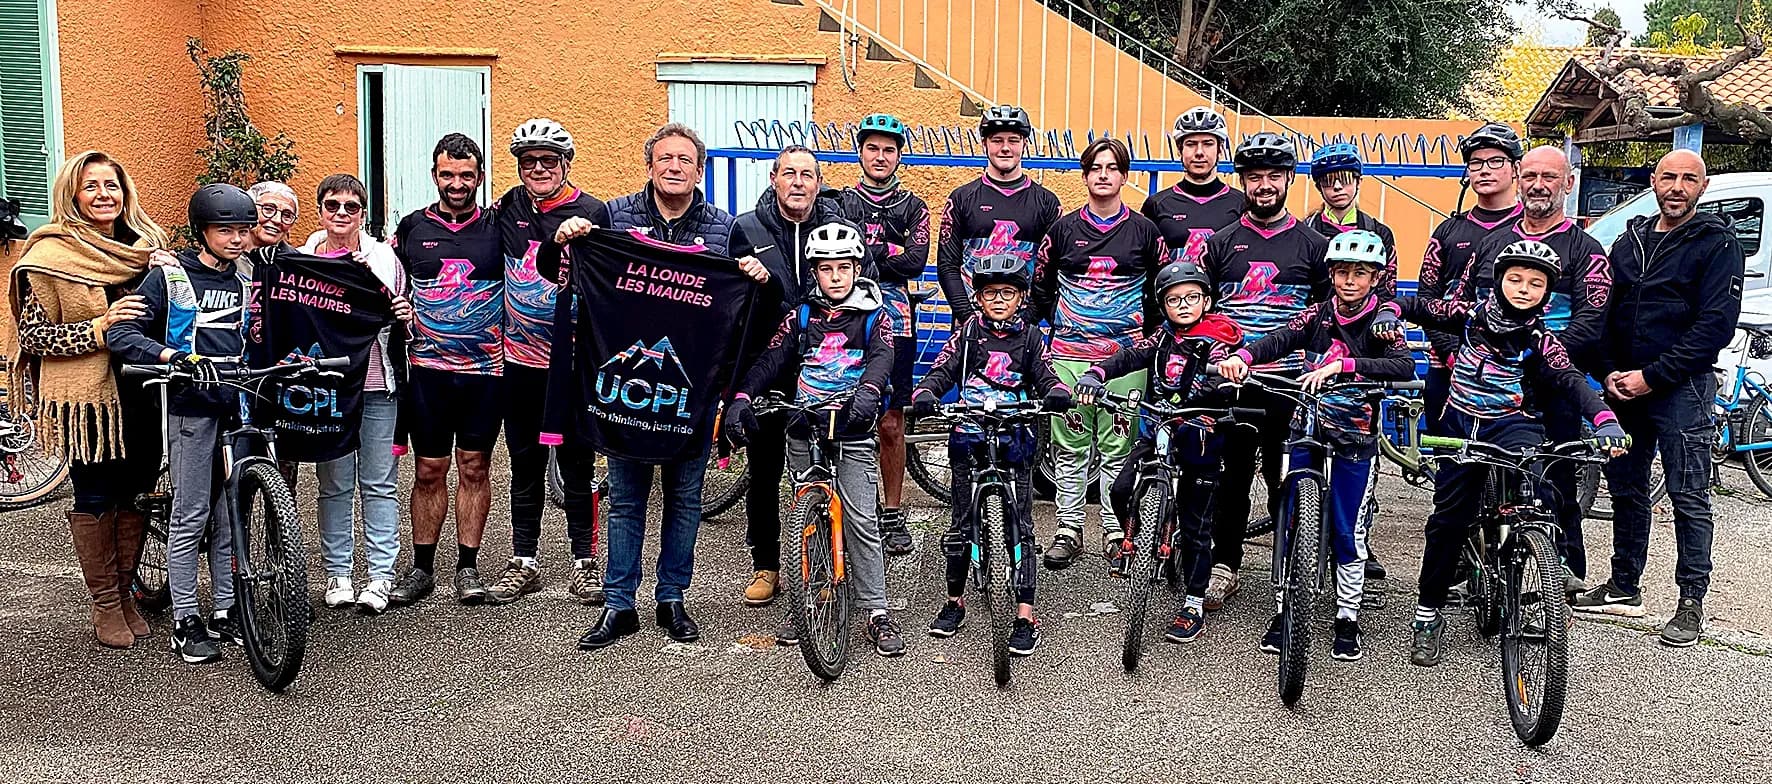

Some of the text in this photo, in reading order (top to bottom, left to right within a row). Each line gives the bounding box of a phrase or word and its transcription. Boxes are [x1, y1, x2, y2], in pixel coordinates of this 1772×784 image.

[279, 271, 348, 298] LA LONDE
[626, 262, 707, 289] LA LONDE
[200, 289, 239, 309] NIKE
[270, 286, 297, 302] LES
[298, 291, 352, 315] MAURES
[616, 276, 713, 308] LES MAURES
[276, 382, 344, 418] CPL
[595, 371, 692, 419] UCPL
[608, 412, 652, 431] thinking,
[652, 420, 672, 432] just
[673, 424, 694, 435] ride
